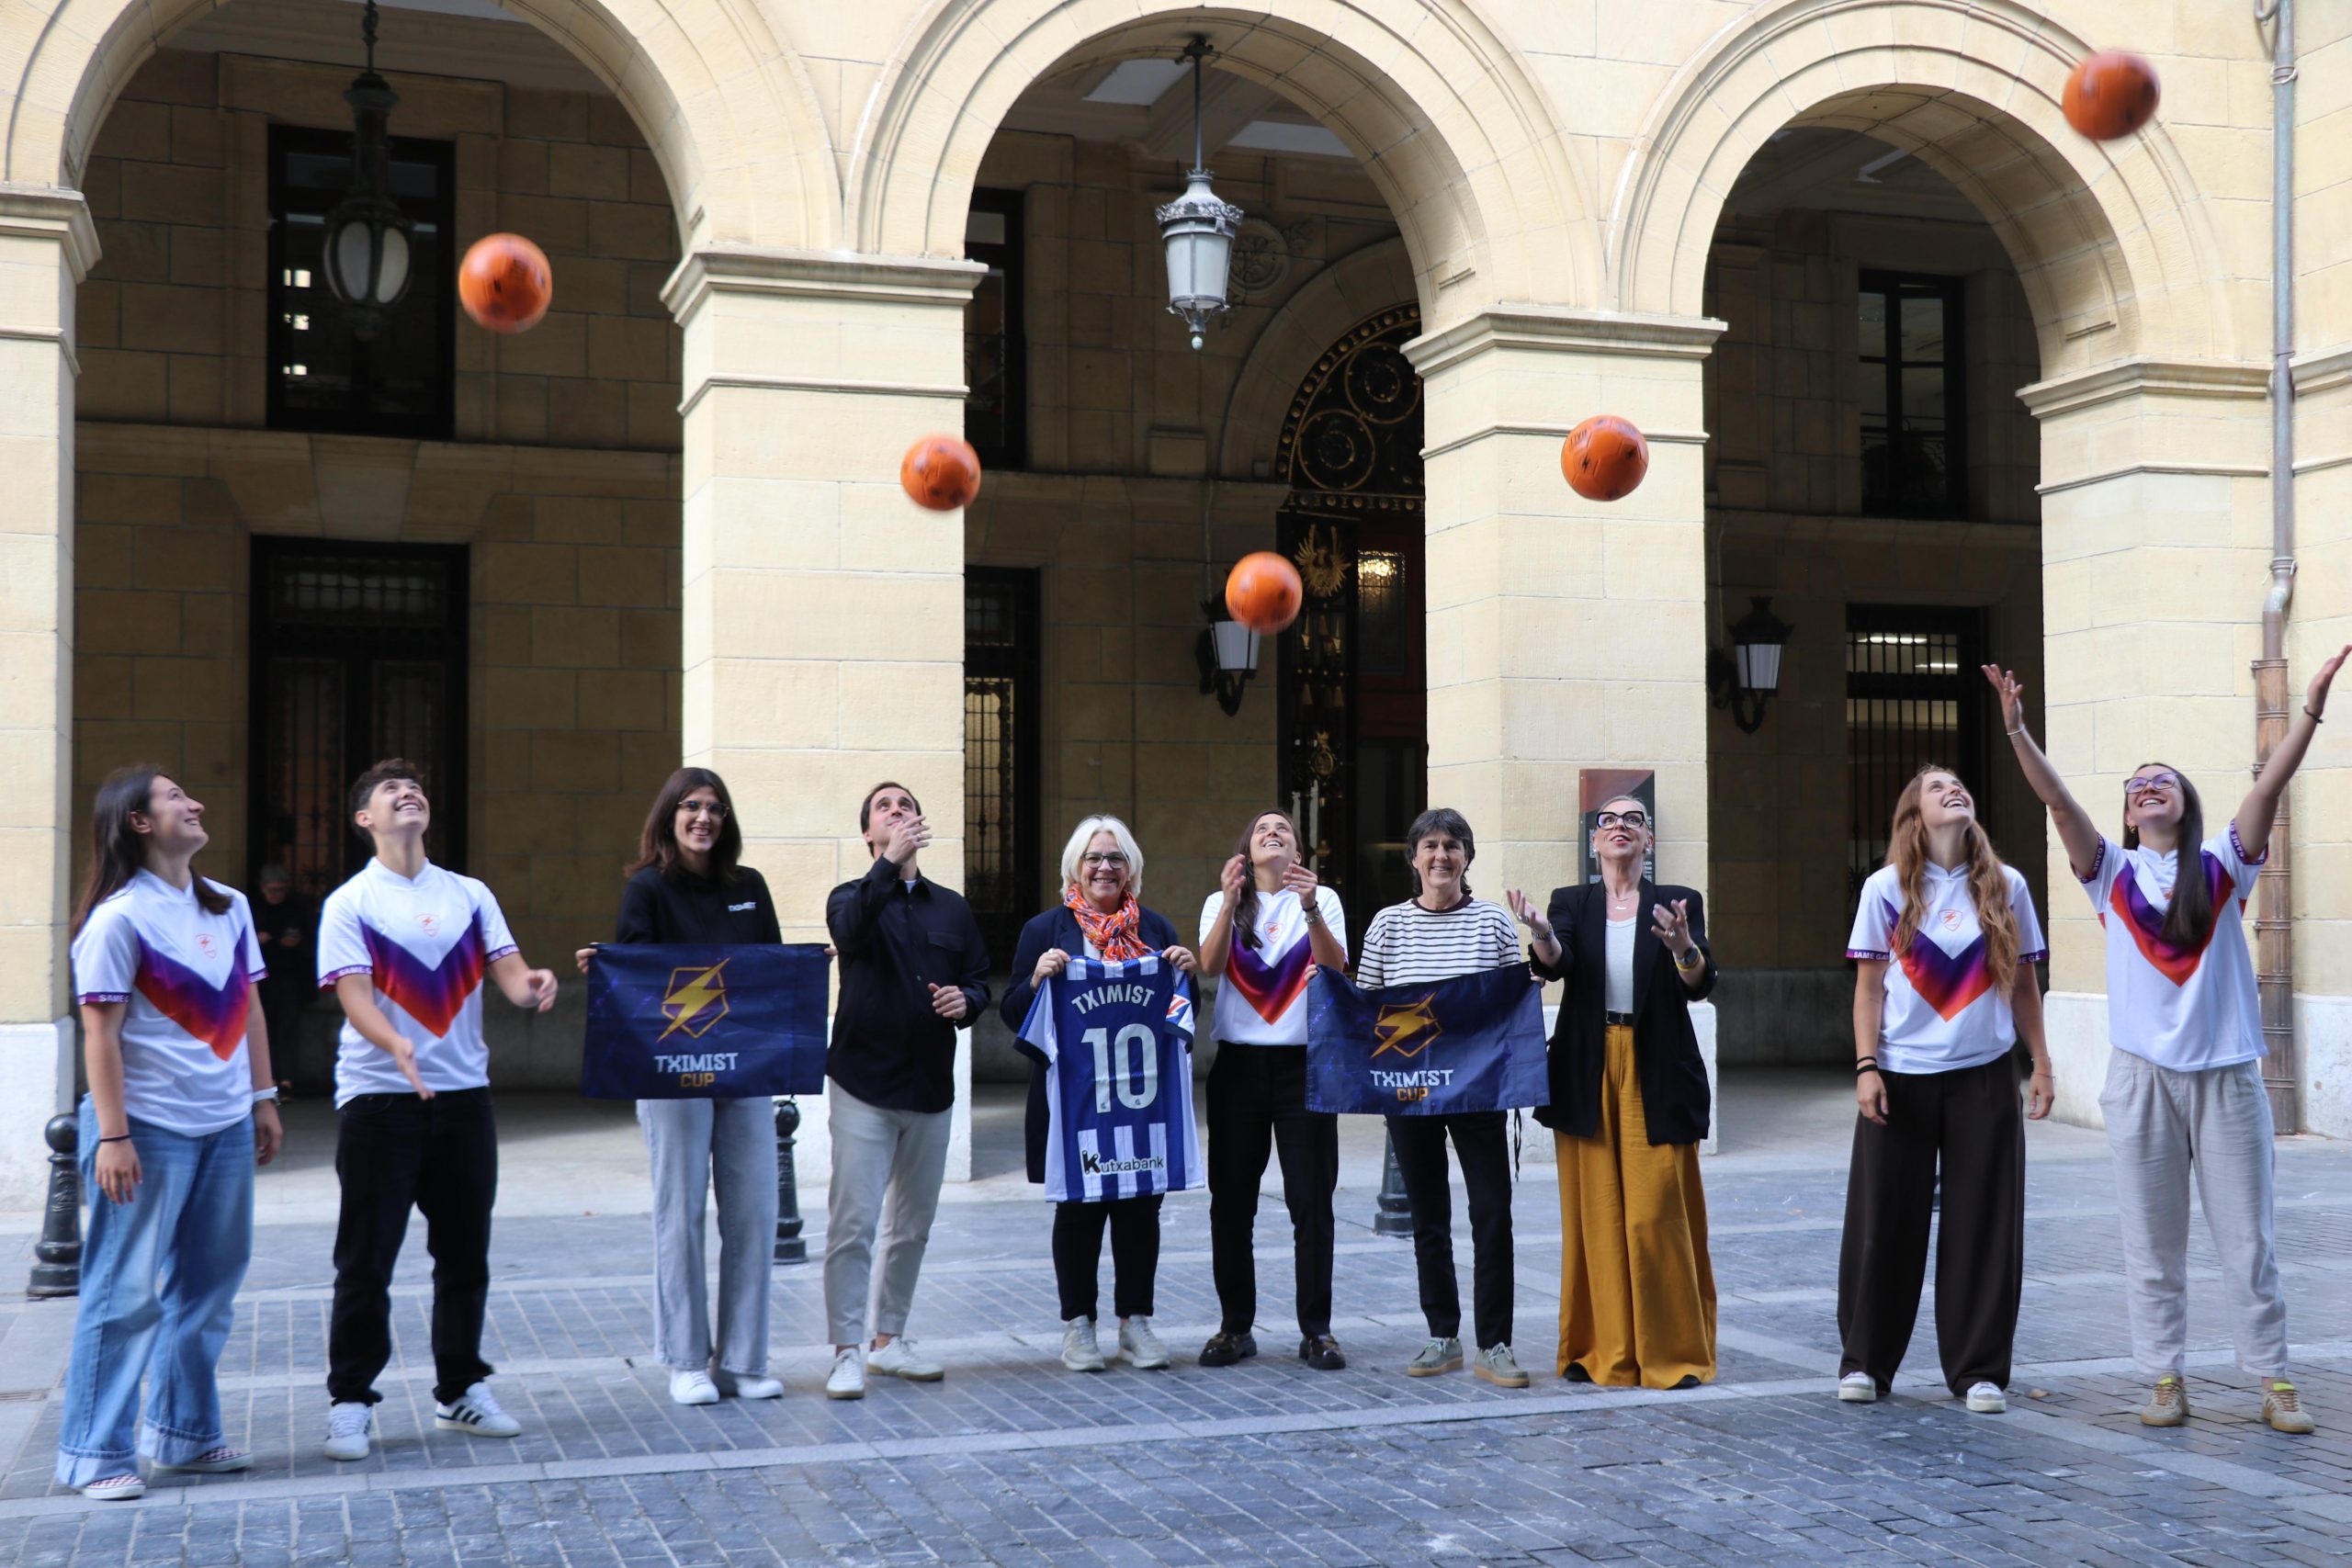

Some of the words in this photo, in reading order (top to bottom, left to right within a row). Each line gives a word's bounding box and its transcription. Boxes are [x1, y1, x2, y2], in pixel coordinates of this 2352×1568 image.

[1853, 951, 1875, 960] SAME
[1071, 984, 1155, 1015] TXIMIST
[654, 1053, 739, 1073] TXIMIST
[1080, 1022, 1158, 1114] 10
[680, 1072, 715, 1088] CUP
[1370, 1069, 1453, 1088] TXIMIST
[1396, 1087, 1430, 1101] CUP
[1081, 1149, 1164, 1175] Kutxabank
